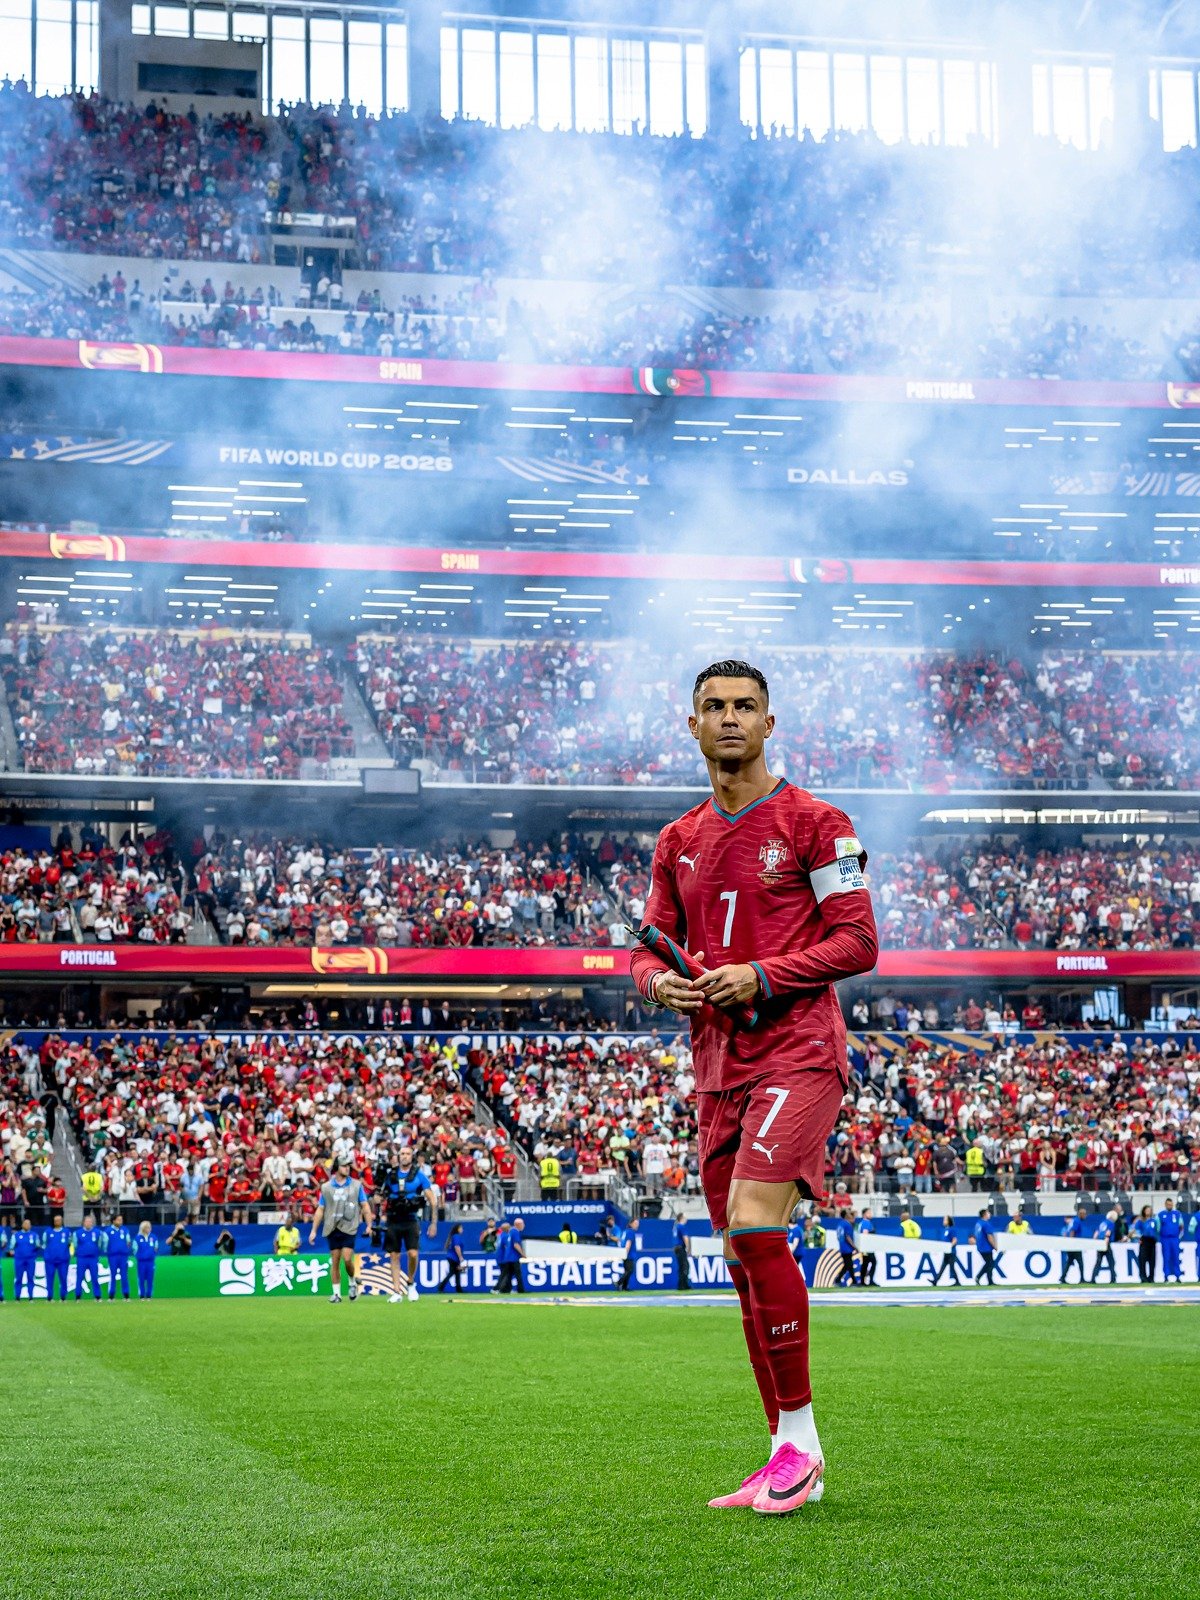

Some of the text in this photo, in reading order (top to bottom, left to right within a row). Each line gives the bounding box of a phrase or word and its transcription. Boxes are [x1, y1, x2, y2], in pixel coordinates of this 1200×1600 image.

[380, 361, 423, 380] SPAIN
[906, 382, 975, 400] PORTUGAL
[219, 447, 453, 472] FIFA WORLD CUP 2026
[787, 468, 909, 486] DALLAS
[441, 552, 480, 570] SPAIN
[1160, 567, 1200, 585] PORTU
[720, 890, 739, 948] 7
[60, 949, 117, 966] PORTUGAL
[583, 955, 615, 969] SPAIN
[1056, 956, 1108, 970] PORTUGAL
[756, 1087, 791, 1138] 7
[521, 1205, 554, 1215] WORLD
[554, 1205, 573, 1214] CUP
[261, 1257, 330, 1293] 蒙牛
[419, 1258, 518, 1288] UNITE
[635, 1256, 674, 1285] OF
